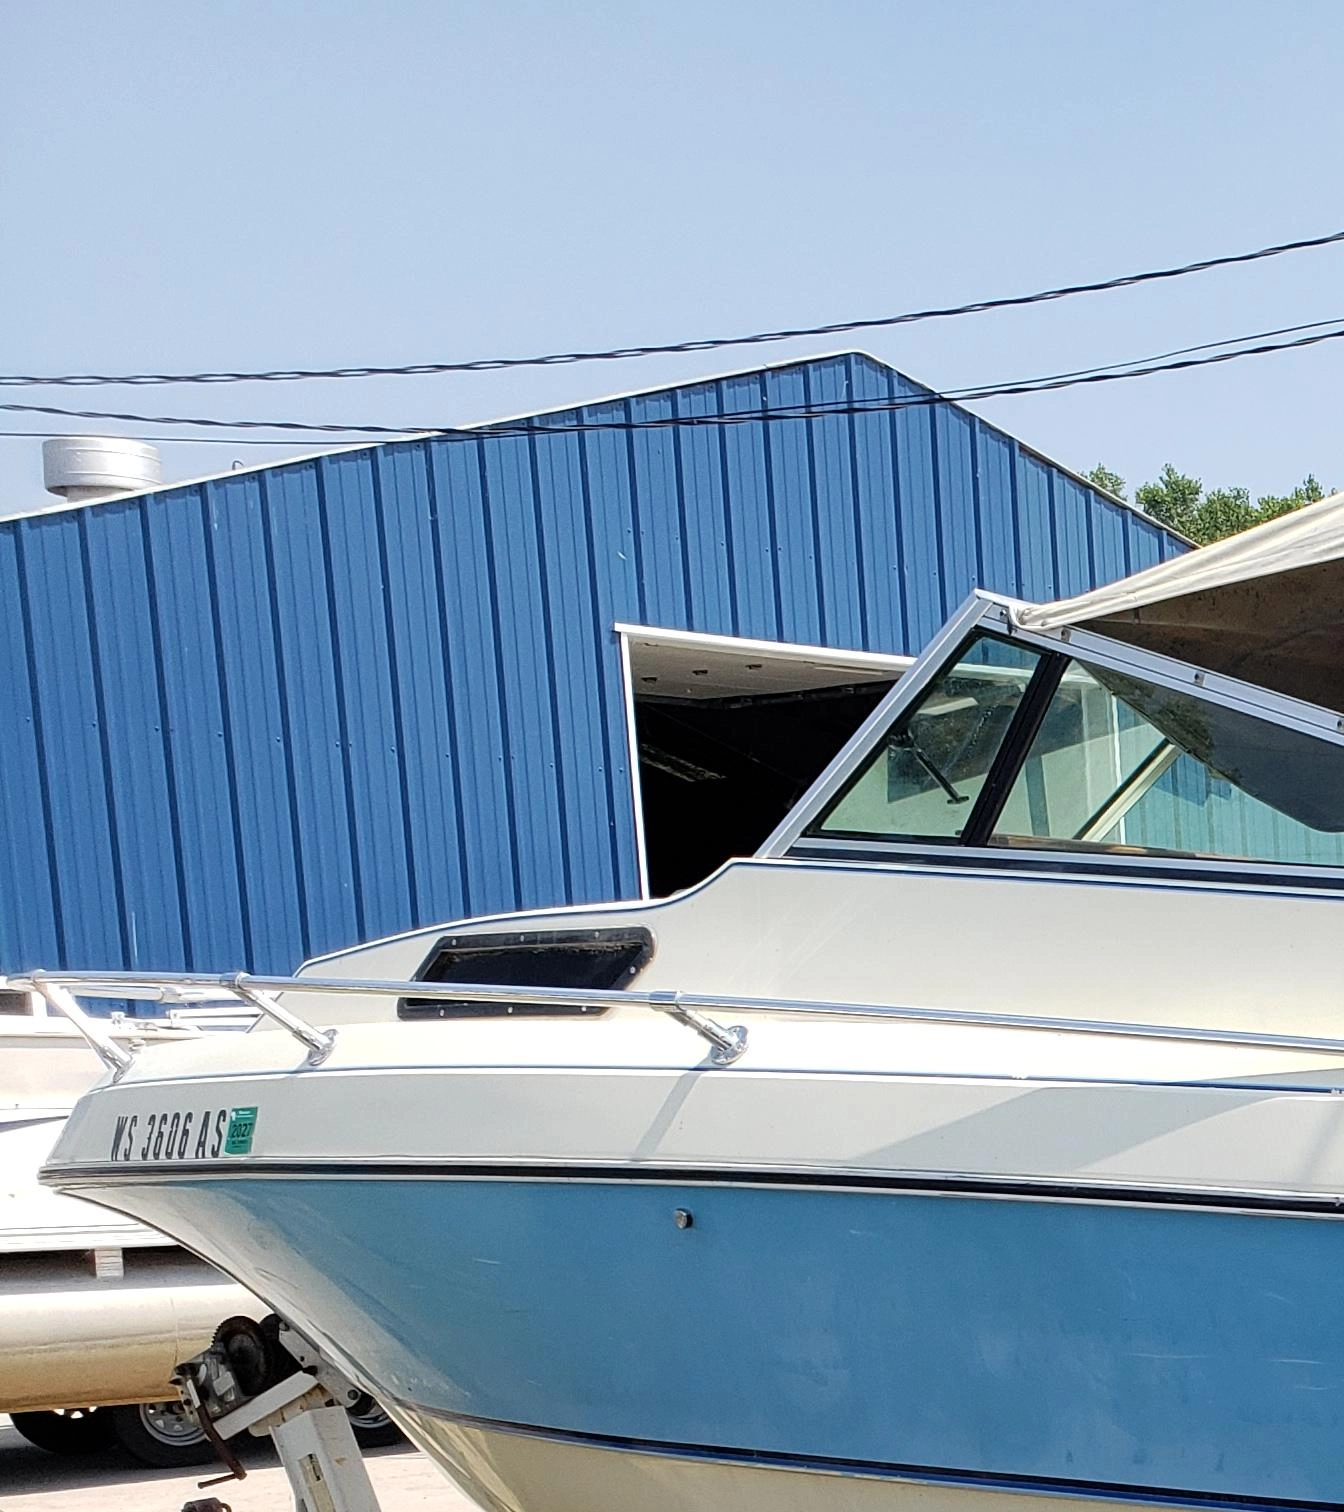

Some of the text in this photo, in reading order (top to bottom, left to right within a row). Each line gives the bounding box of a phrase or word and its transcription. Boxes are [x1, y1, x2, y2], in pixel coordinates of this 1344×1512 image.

[111, 1109, 227, 1161] WS 3606 AS
